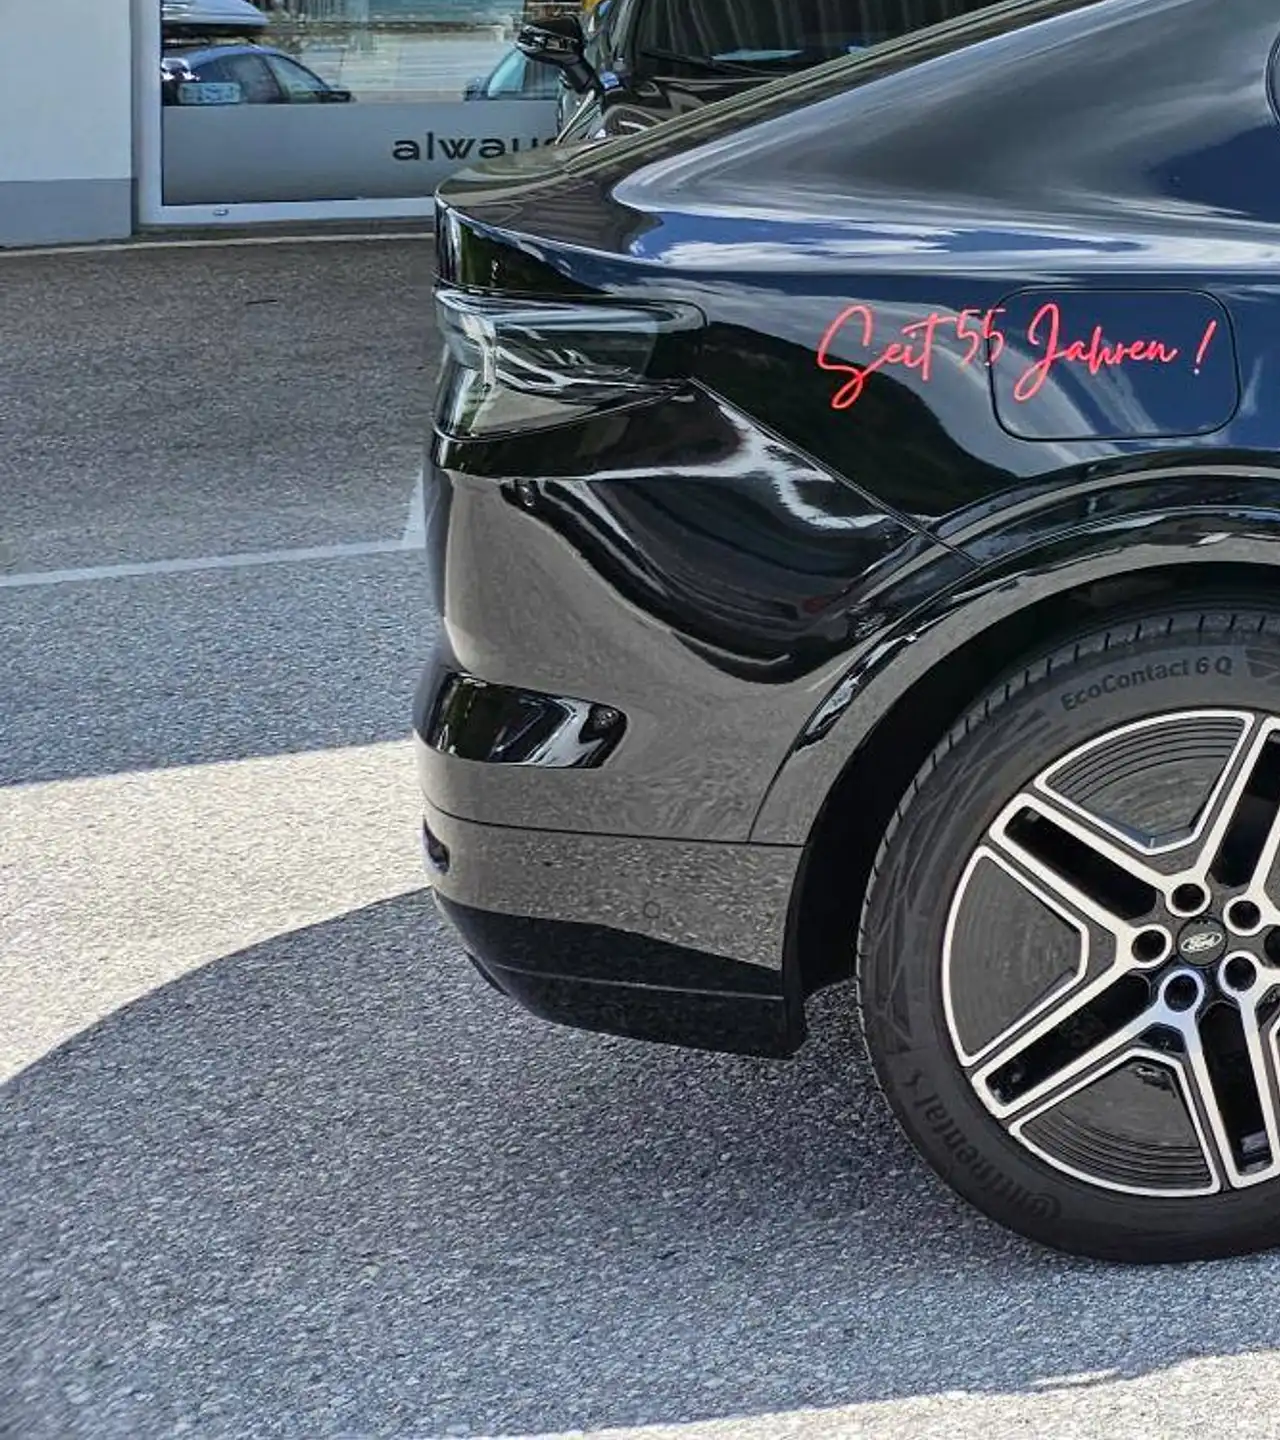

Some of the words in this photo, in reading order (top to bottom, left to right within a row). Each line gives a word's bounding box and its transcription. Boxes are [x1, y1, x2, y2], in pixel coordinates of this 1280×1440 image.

[817, 304, 957, 409] Seit
[1013, 302, 1177, 402] Jahren
[1060, 660, 1189, 711] EcoContact
[1195, 656, 1210, 675] 6
[1215, 656, 1233, 676] Q
